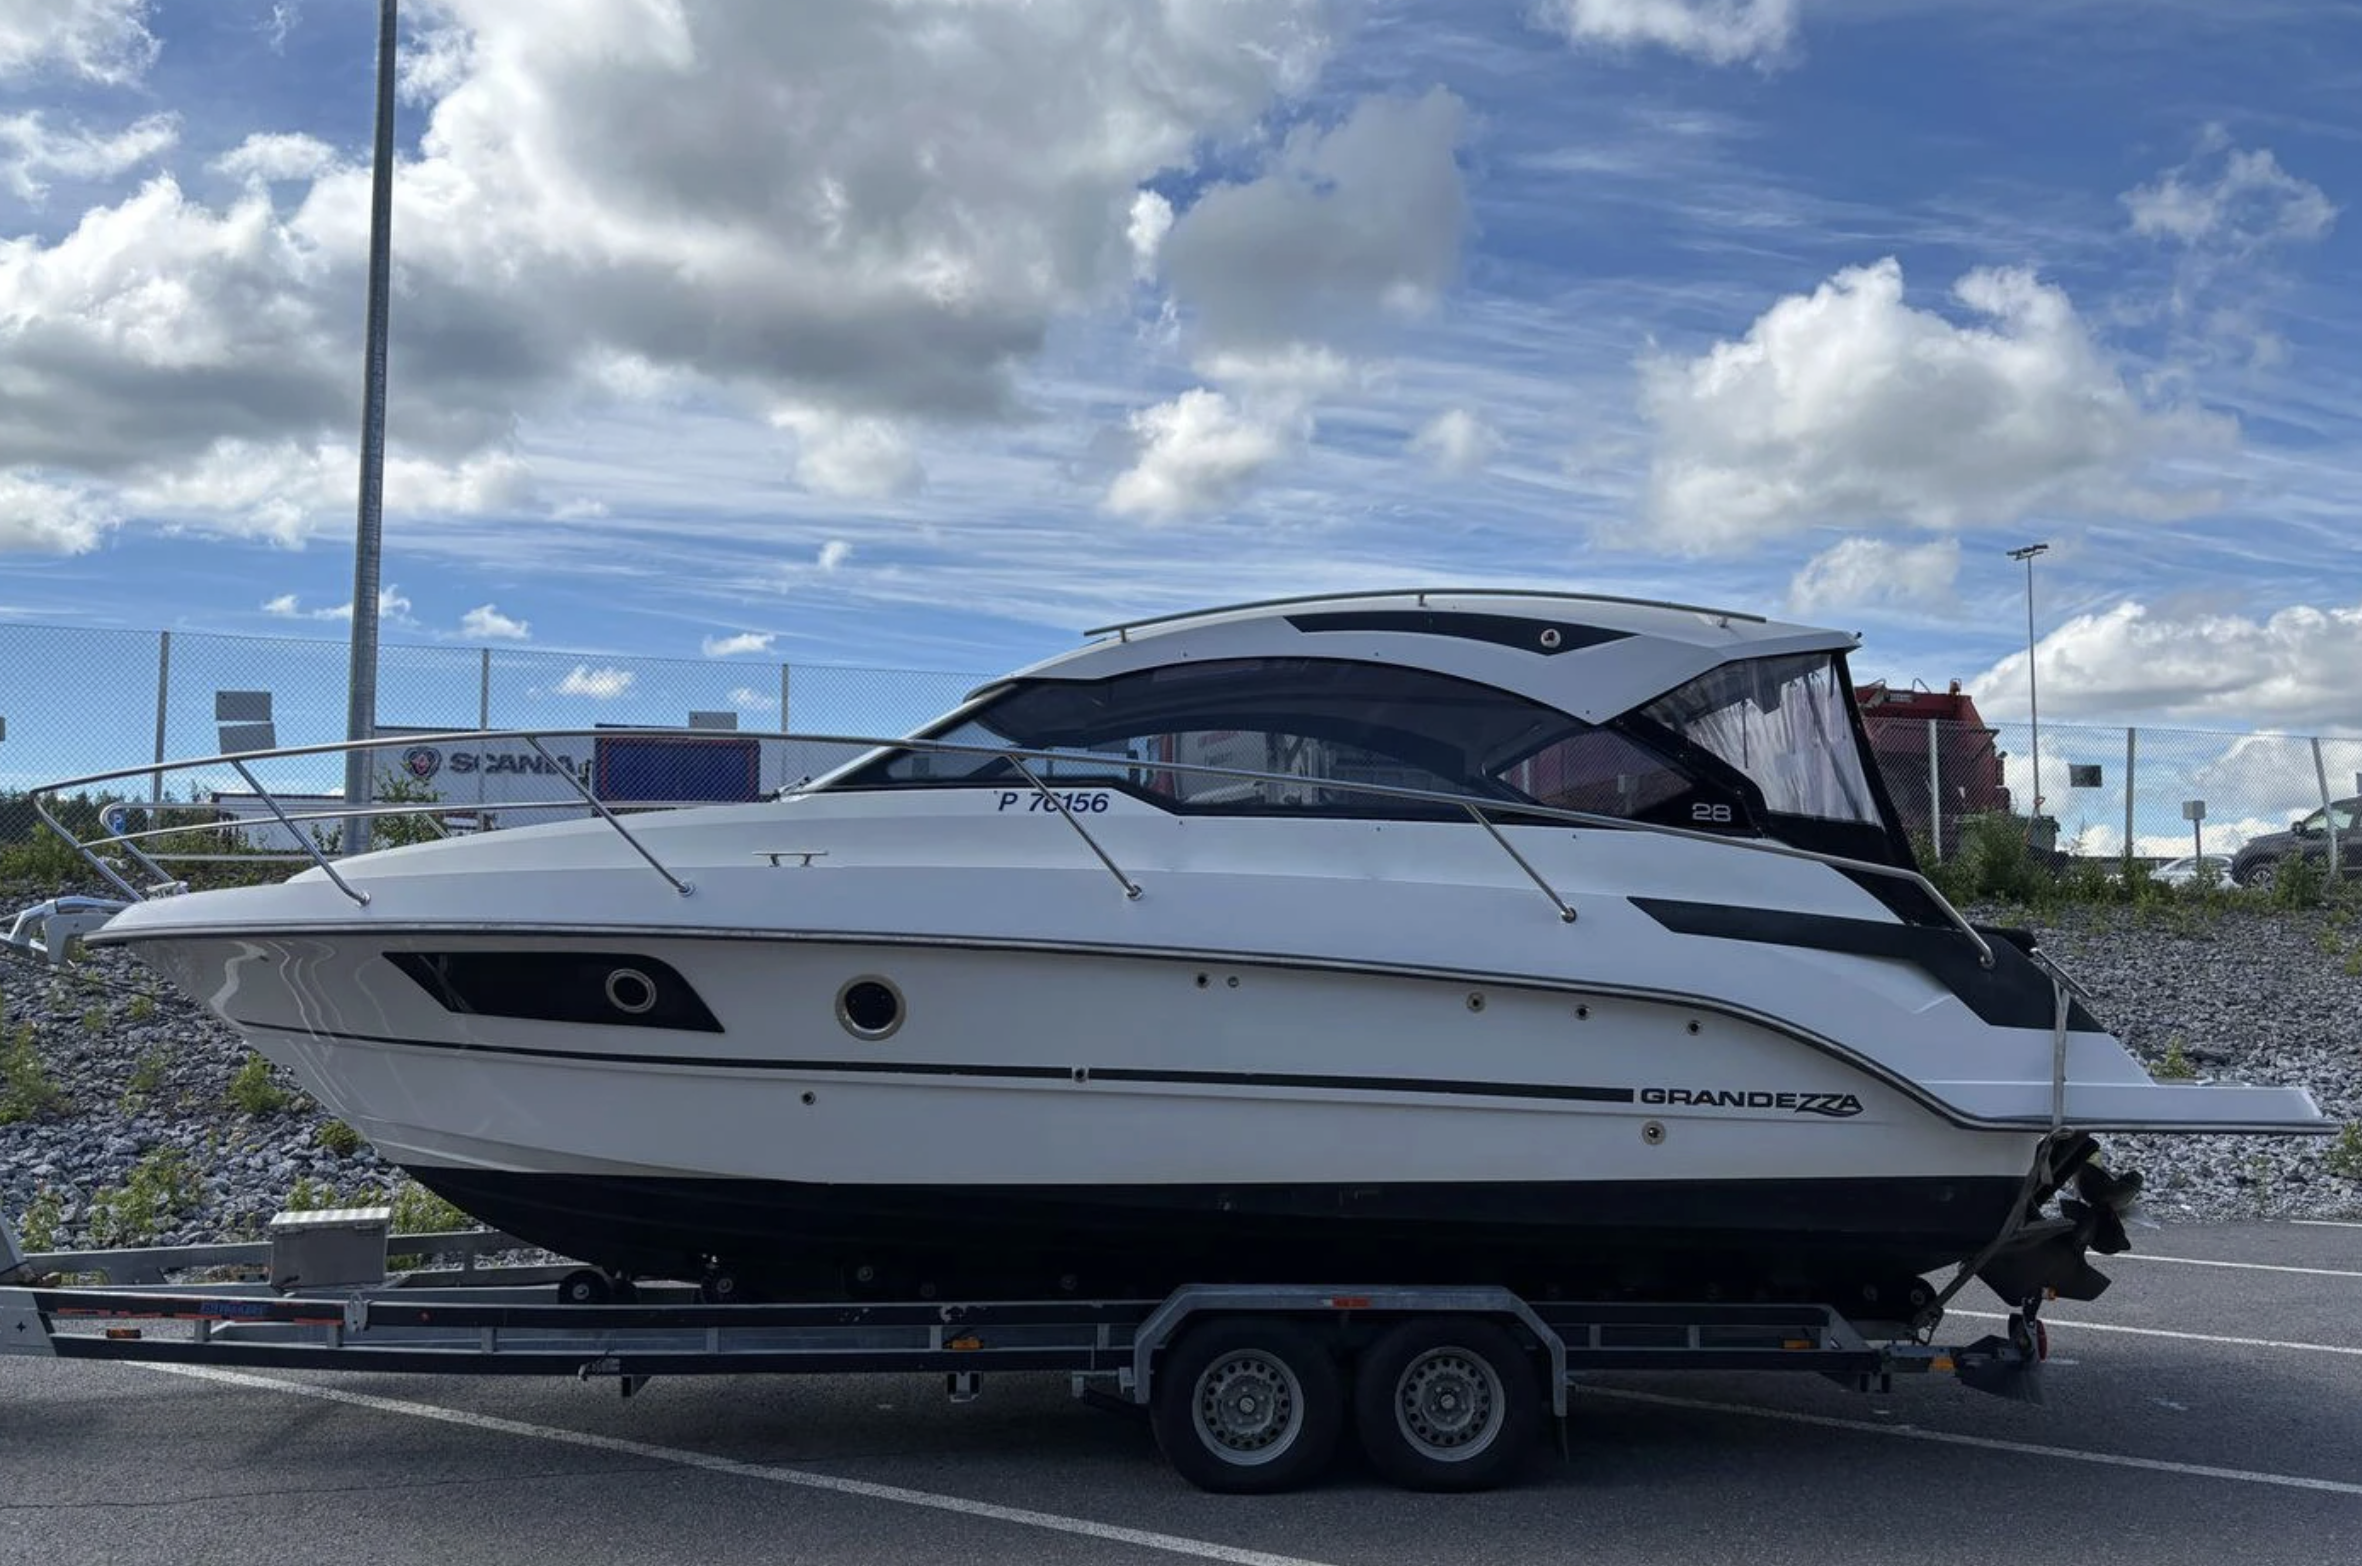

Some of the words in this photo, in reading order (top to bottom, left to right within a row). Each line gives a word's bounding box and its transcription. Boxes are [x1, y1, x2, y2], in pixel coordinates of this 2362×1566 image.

[998, 791, 1018, 812] P
[1029, 791, 1110, 813] 76156
[1692, 803, 1731, 822] 28
[1641, 1088, 1864, 1118] GRANDEZZA
